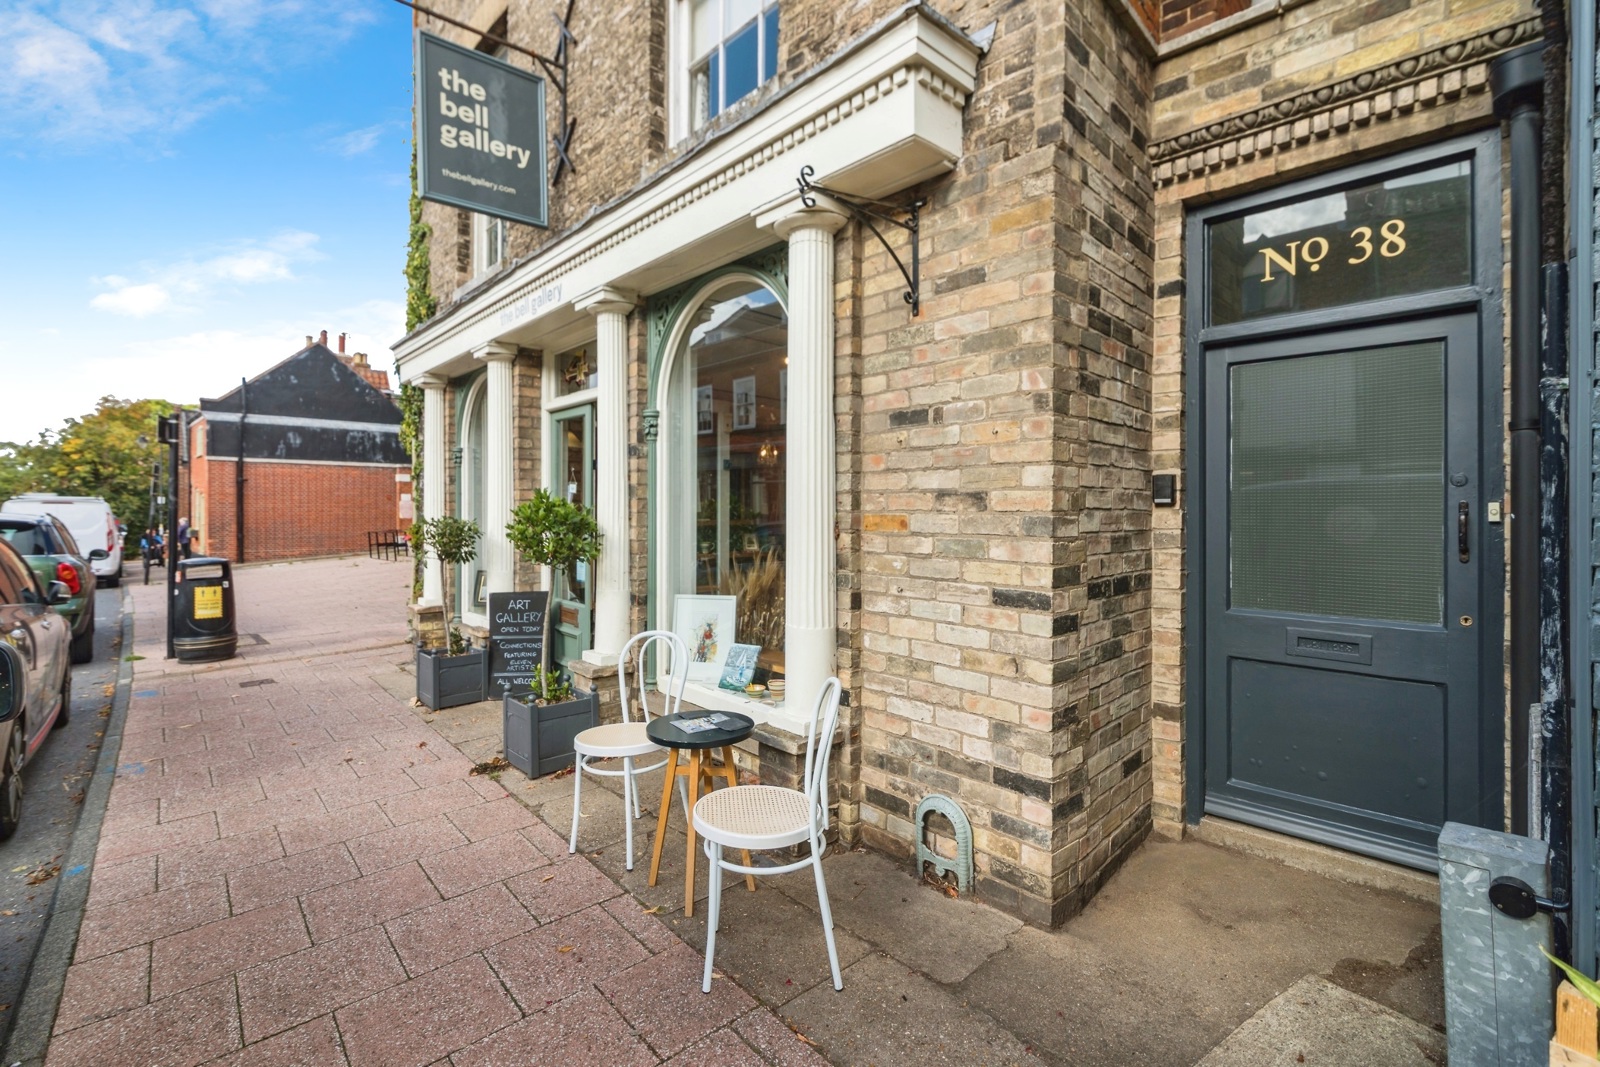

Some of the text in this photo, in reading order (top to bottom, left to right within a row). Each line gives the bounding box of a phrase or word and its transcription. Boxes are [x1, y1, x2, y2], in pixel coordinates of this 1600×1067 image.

[438, 67, 486, 101] the
[440, 92, 489, 129] bell
[440, 124, 531, 169] gallery
[442, 168, 516, 195] thebellgallery.com
[1348, 219, 1407, 265] 38
[514, 297, 530, 319] bell
[531, 283, 562, 315] gallery
[495, 611, 542, 623] GALLERY
[508, 599, 531, 610] ART
